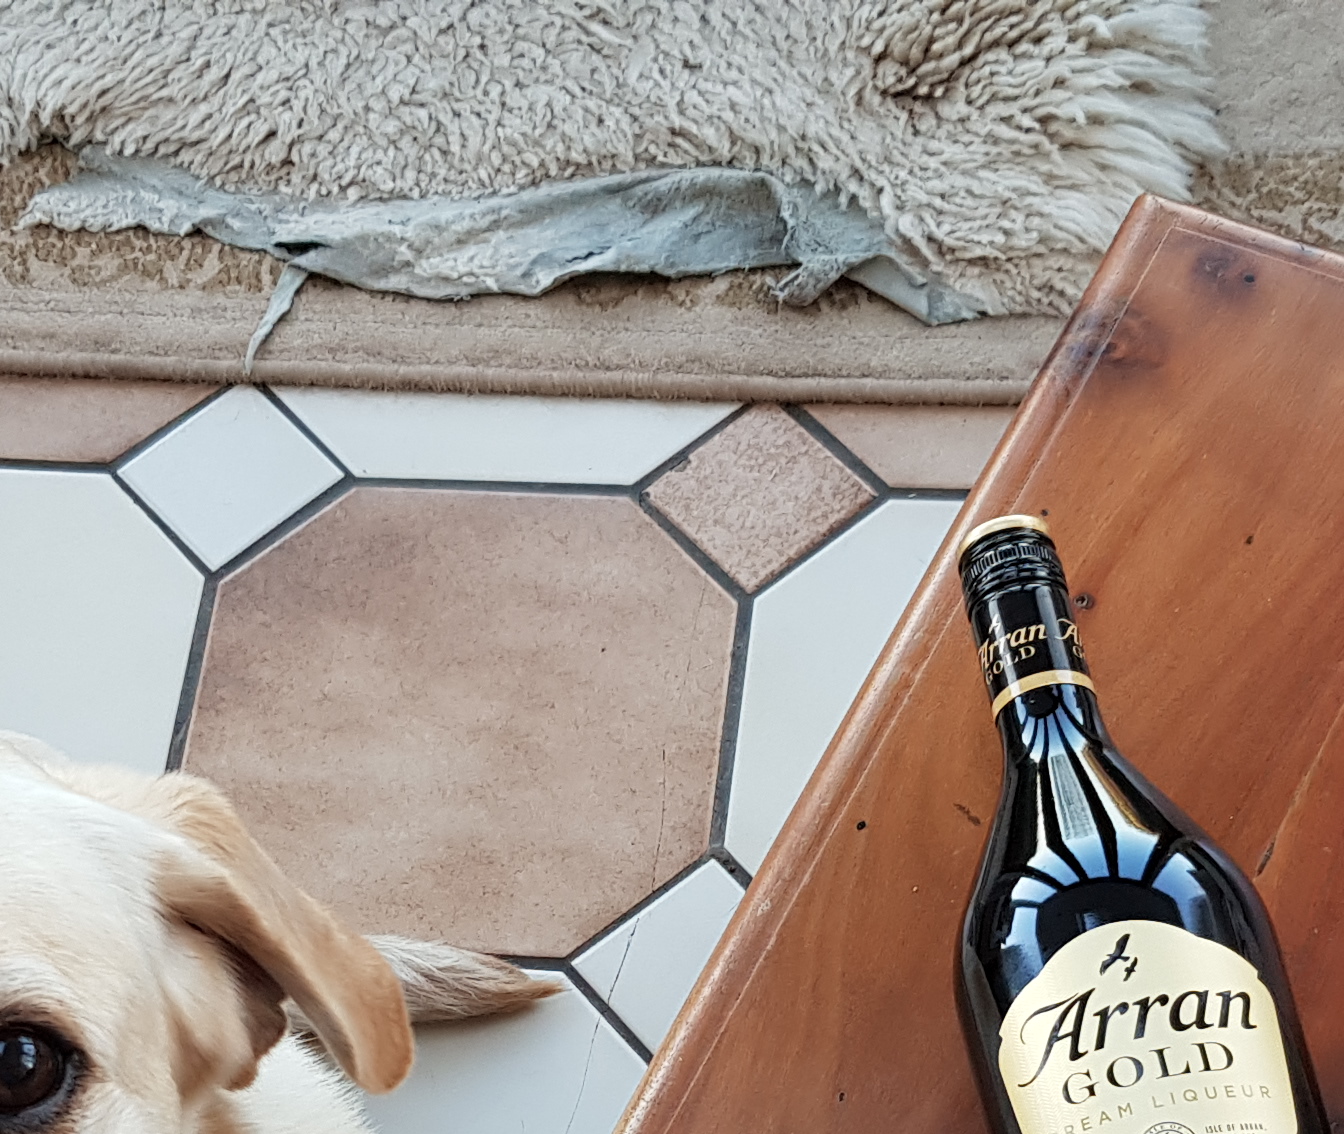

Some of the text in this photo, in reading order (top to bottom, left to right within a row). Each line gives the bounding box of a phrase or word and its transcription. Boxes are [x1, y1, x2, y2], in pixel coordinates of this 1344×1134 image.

[978, 623, 1047, 673] Arran
[986, 645, 1036, 685] GOLD
[1017, 987, 1257, 1087] Arran
[1062, 1041, 1234, 1105] GOLD
[1151, 1084, 1272, 1109] LIQUEUR
[1205, 1124, 1223, 1133] ISLE
[1227, 1123, 1235, 1131] OF
